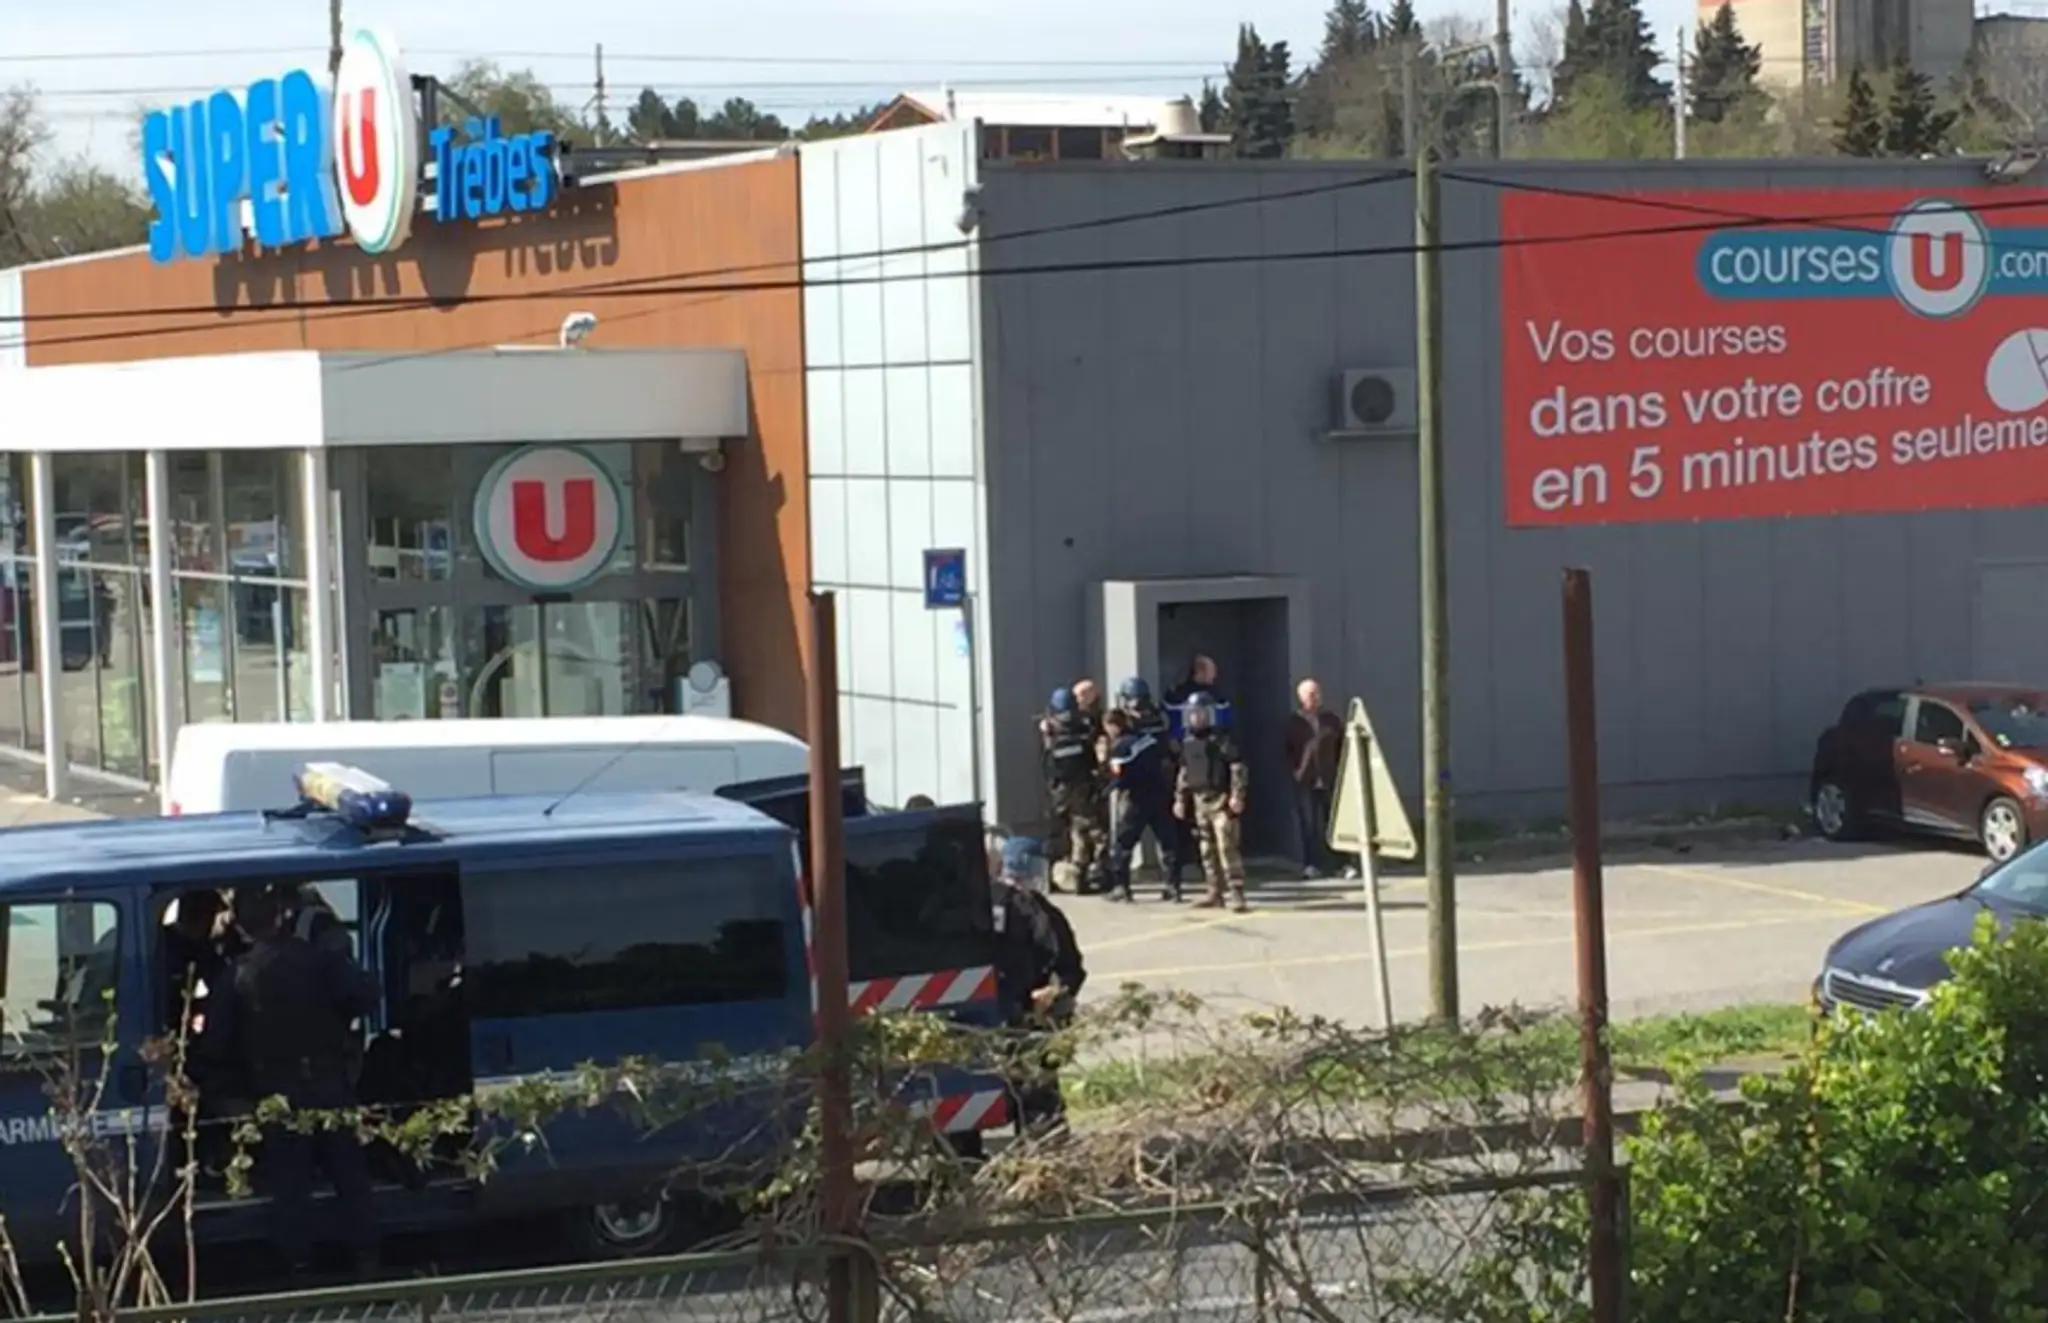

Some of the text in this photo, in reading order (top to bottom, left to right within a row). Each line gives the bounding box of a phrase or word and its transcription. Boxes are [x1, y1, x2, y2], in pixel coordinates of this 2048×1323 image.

[142, 69, 380, 263] SUPER U
[1710, 243, 1881, 285] courses
[1910, 231, 1964, 292] U
[1527, 320, 1788, 362] Vos courses
[1529, 366, 1931, 436] dans votre coffre
[1531, 412, 2048, 511] en 5 minutes seuleme
[512, 478, 596, 562] U
